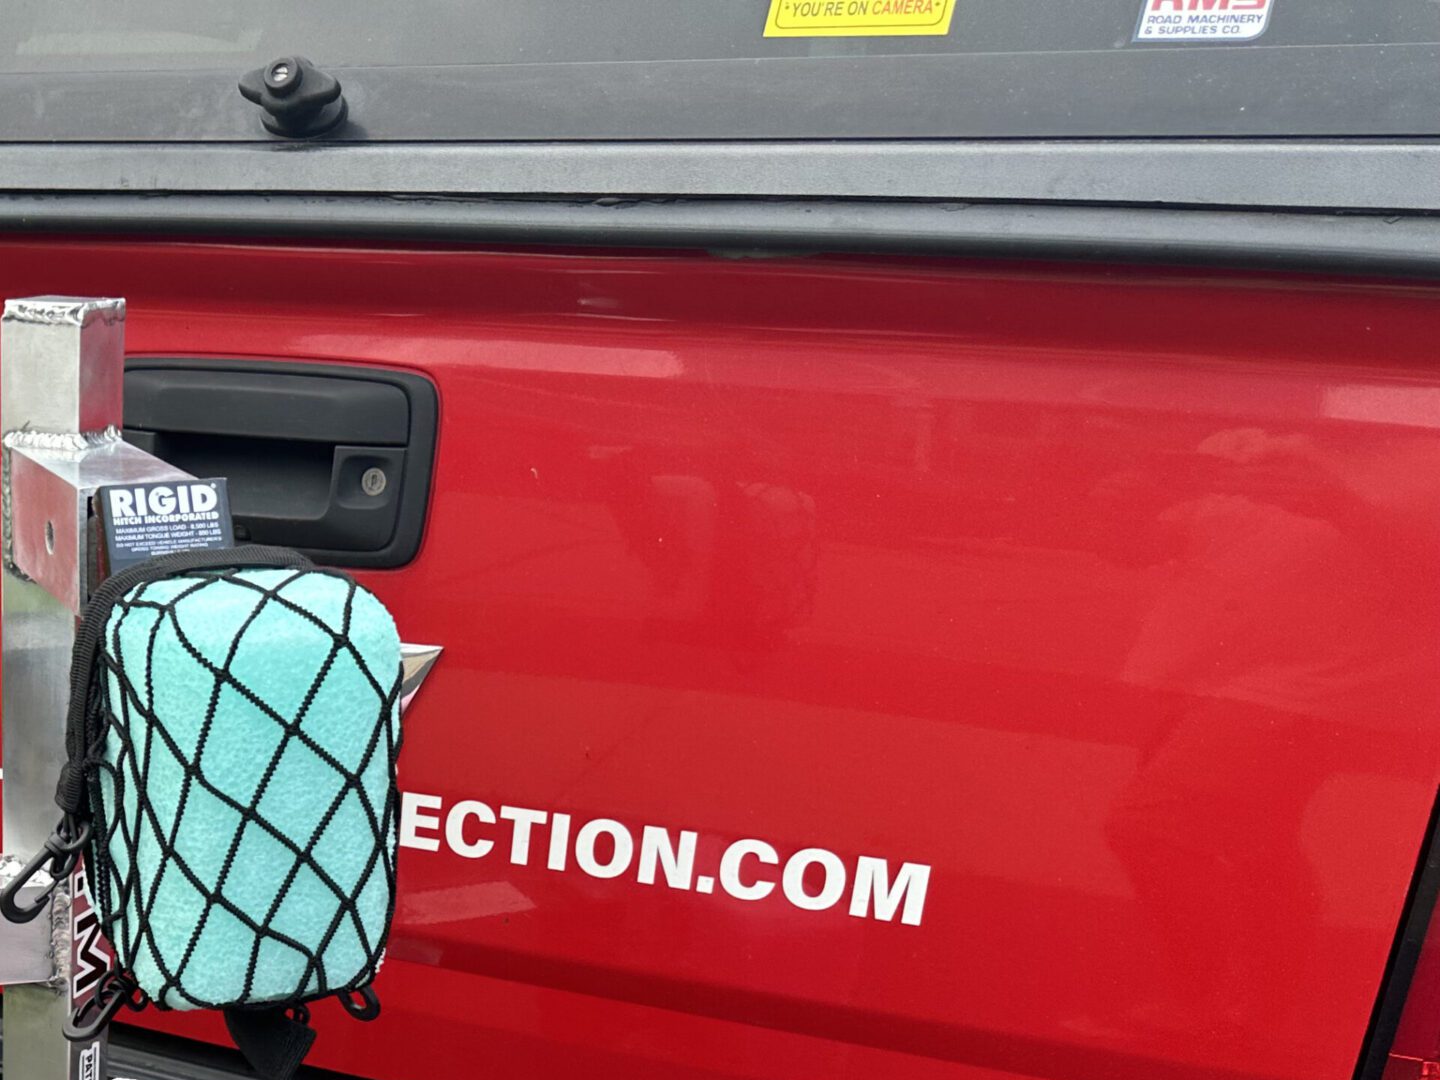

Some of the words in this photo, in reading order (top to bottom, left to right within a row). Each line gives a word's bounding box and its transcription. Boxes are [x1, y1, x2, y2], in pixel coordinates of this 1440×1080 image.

[847, 1, 868, 16] ON
[872, 0, 934, 15] CAMERA
[1147, 15, 1183, 24] ROAD
[1187, 14, 1264, 24] MACHINERY
[1144, 26, 1153, 35] &
[1158, 25, 1217, 34] SUPPLIES
[109, 484, 217, 518] RIGID
[113, 516, 142, 526] HITCH
[144, 511, 219, 524] INCORPORATED
[115, 526, 146, 534] MAXIMUM
[146, 525, 168, 533] GROSS
[169, 524, 186, 532] LOAD
[115, 534, 145, 542] MAXIMUM
[145, 532, 170, 540] TONGUE
[170, 531, 195, 539] WEIGHT
[209, 528, 221, 536] LBS
[398, 790, 931, 928] ECTION.COM
